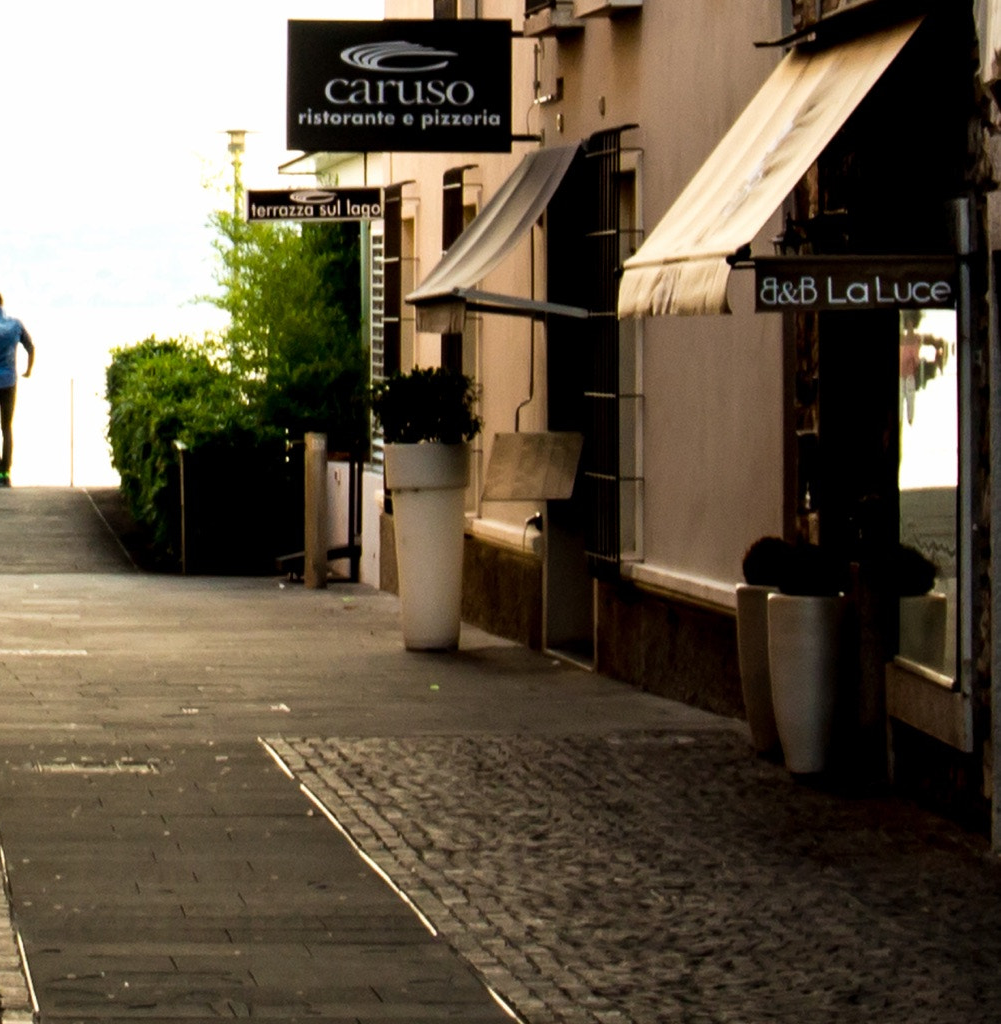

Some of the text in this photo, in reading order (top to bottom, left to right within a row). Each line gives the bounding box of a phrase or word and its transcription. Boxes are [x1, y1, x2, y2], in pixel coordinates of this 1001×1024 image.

[324, 78, 475, 106] caruso
[298, 108, 501, 130] ristorante e pizzeria
[251, 199, 381, 218] terrazza sul lago
[760, 277, 818, 305] B&B
